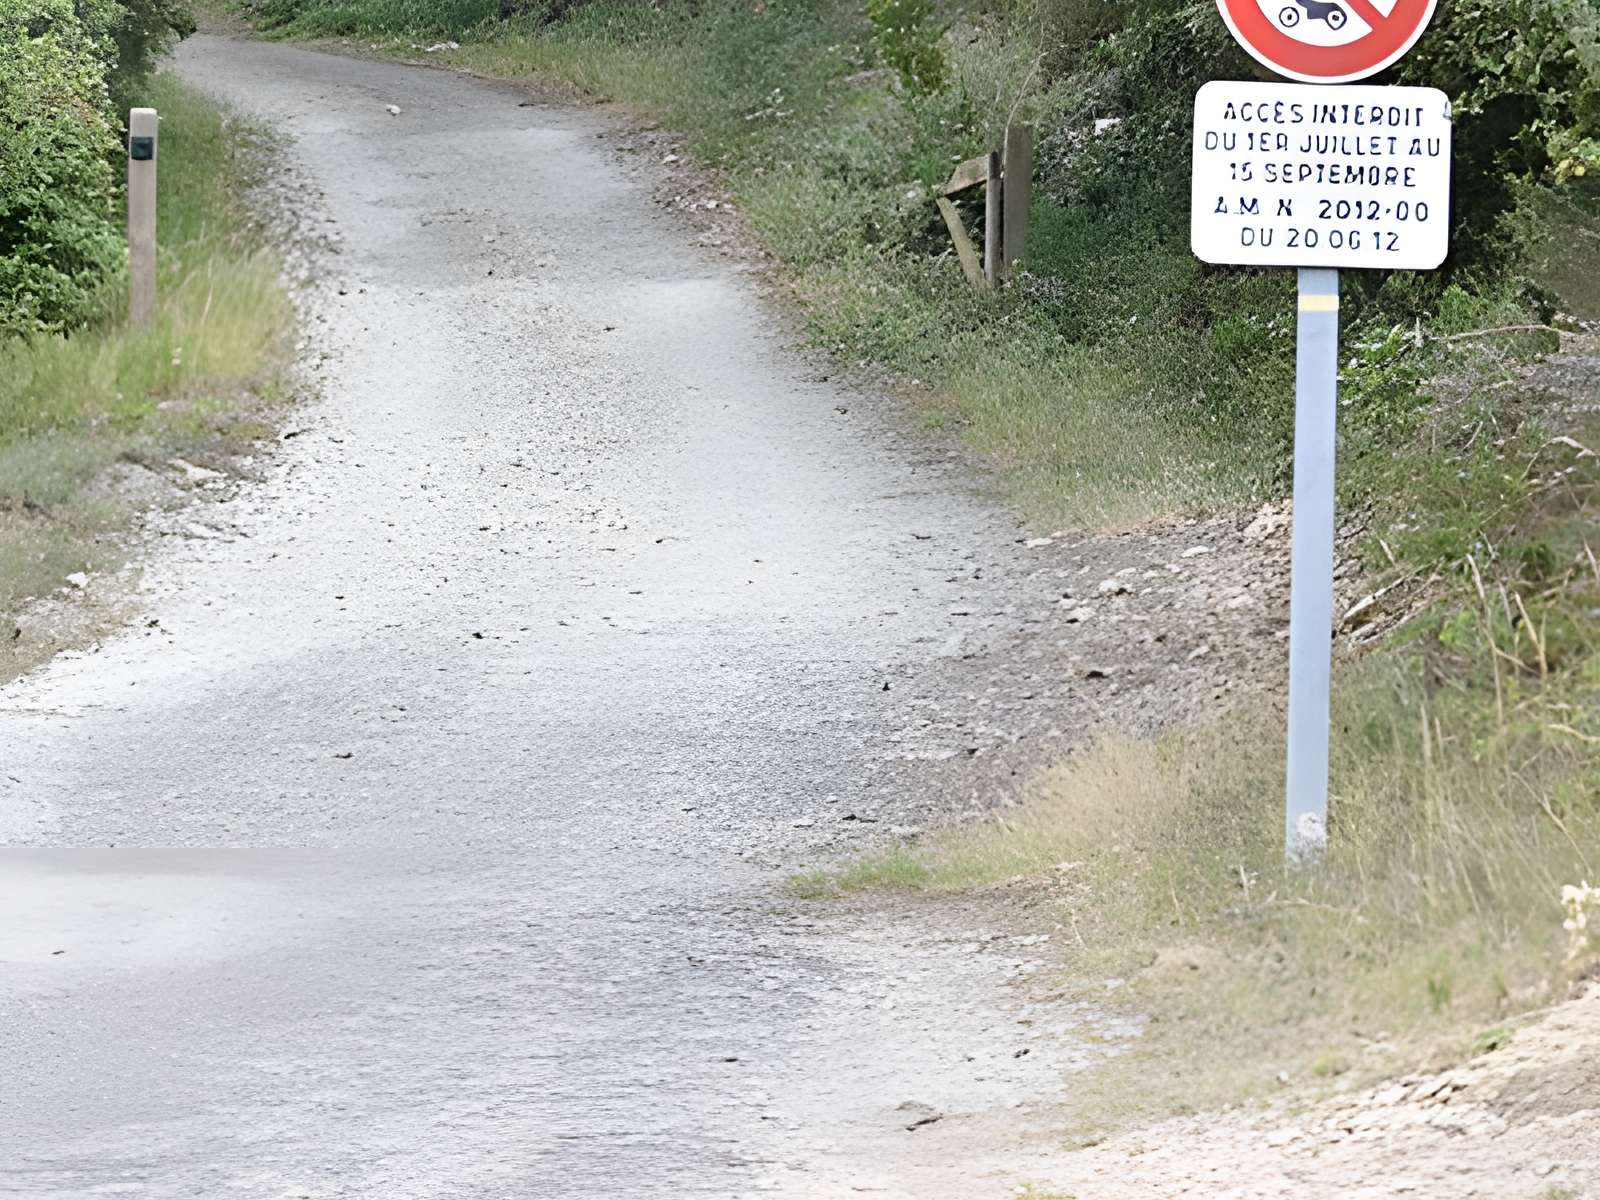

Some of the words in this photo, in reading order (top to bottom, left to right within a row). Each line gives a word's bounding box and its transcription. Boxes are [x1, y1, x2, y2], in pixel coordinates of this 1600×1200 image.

[1312, 104, 1424, 127] INTERDIT
[1205, 131, 1236, 151] DU
[1299, 134, 1397, 156] JUILLET
[1408, 137, 1440, 157] AU
[1229, 161, 1253, 182] 15
[1241, 226, 1273, 247] DU
